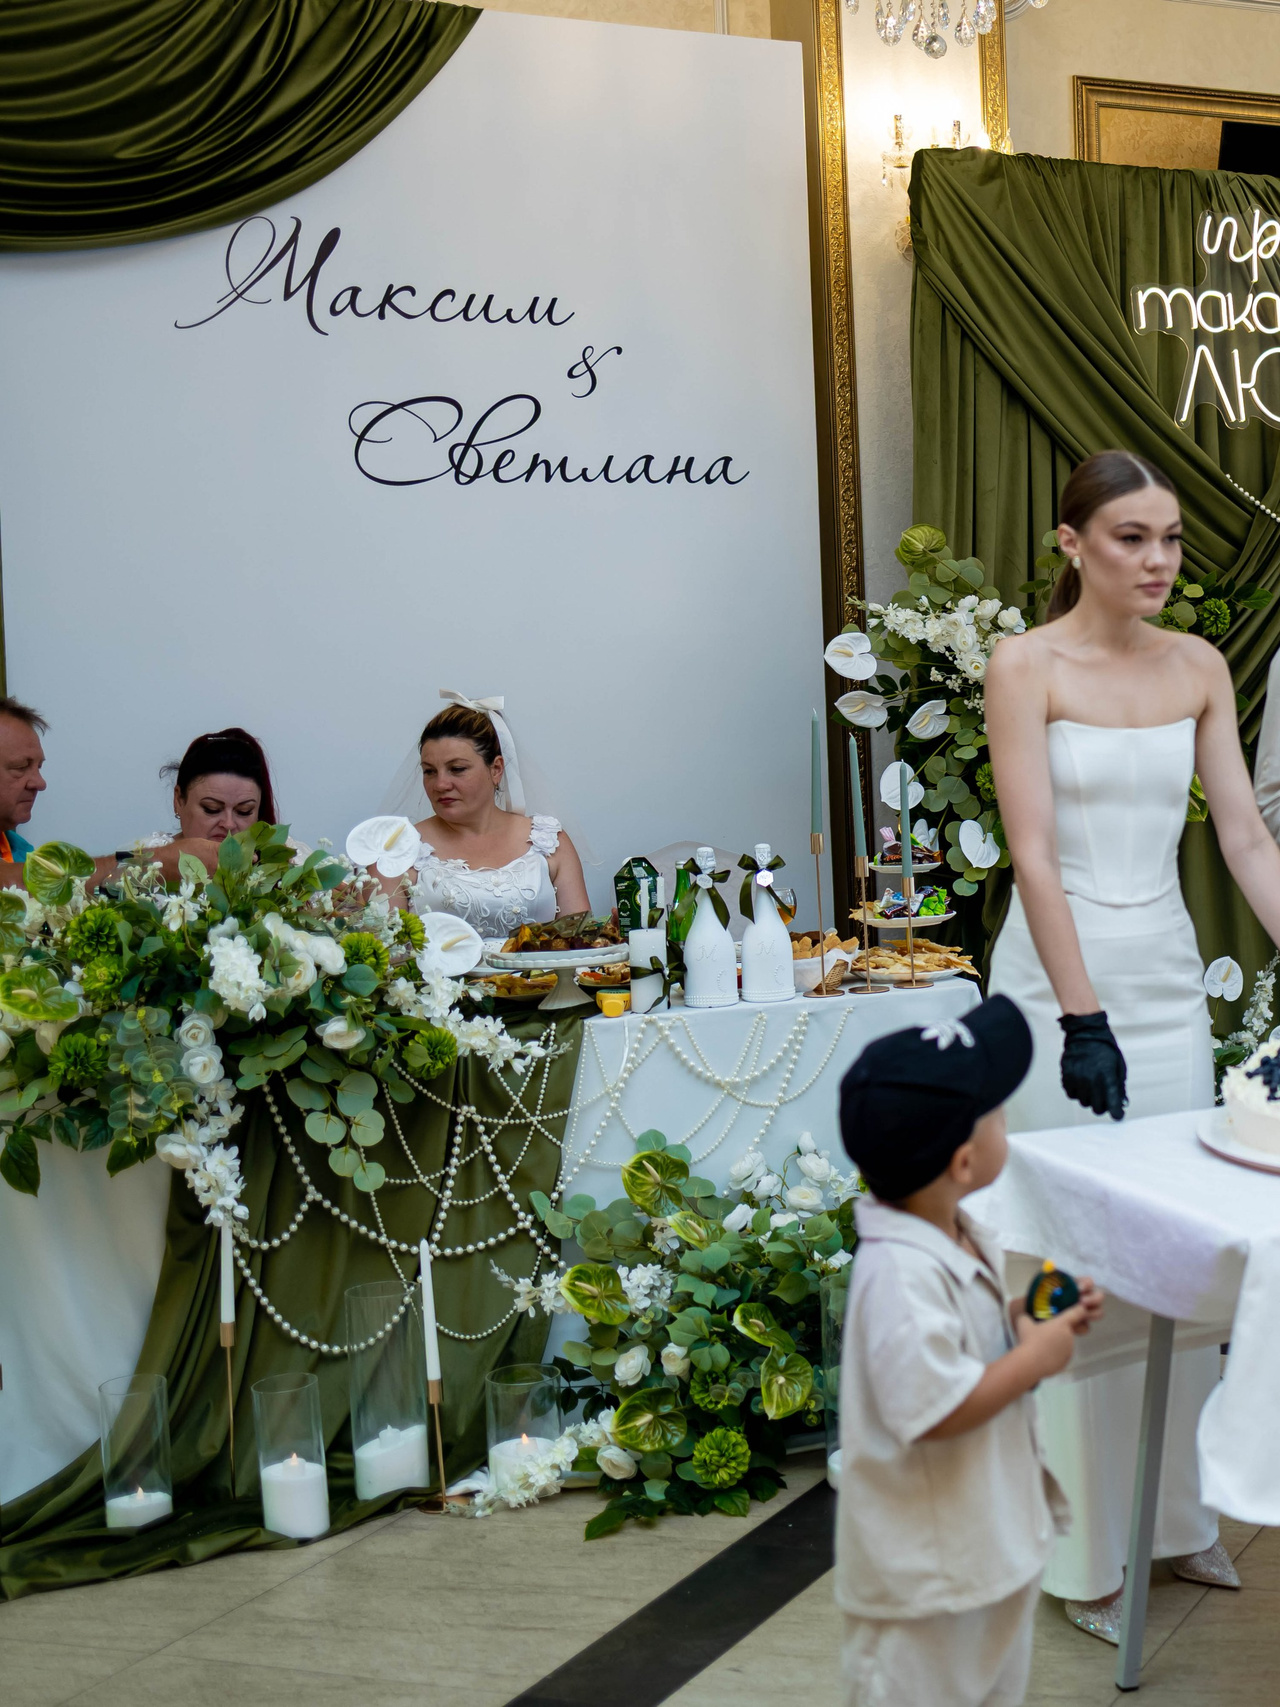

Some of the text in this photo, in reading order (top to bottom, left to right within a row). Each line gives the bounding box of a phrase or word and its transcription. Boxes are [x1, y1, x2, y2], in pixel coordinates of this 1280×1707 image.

[174, 215, 576, 336] Максим
[567, 345, 623, 398] &
[348, 393, 750, 487] Светлана
